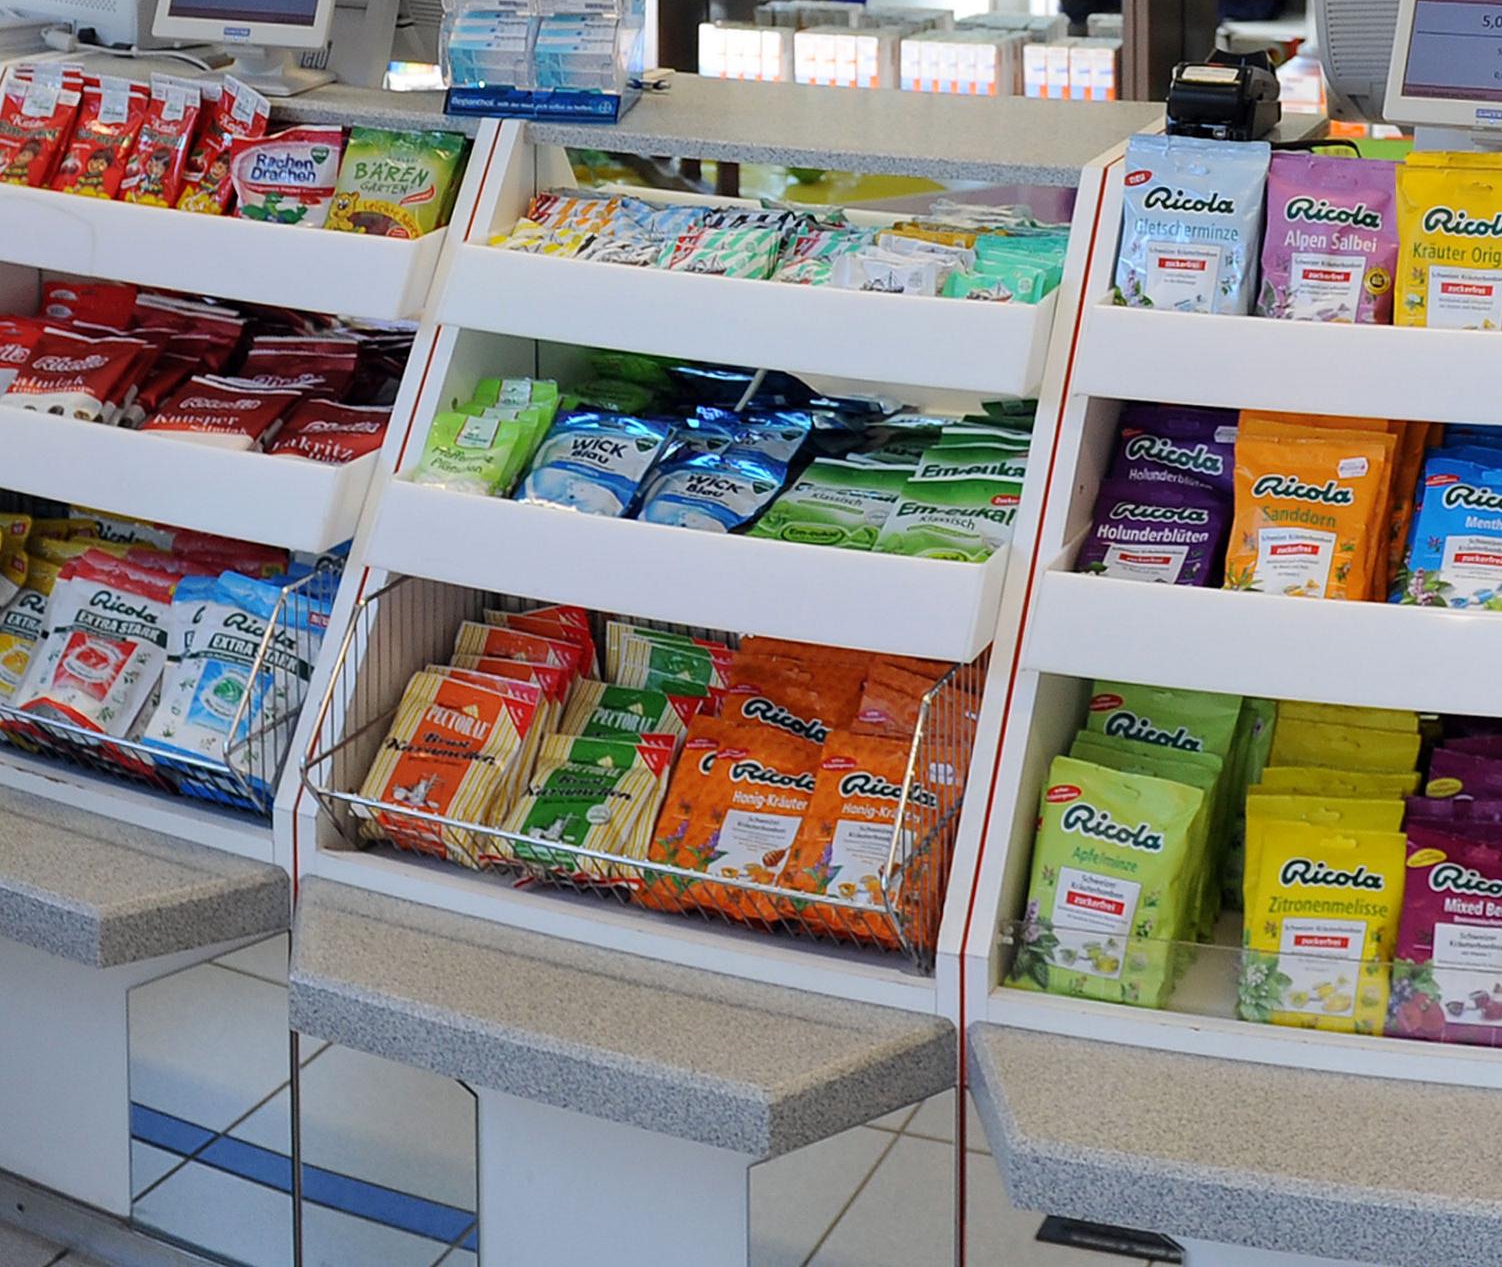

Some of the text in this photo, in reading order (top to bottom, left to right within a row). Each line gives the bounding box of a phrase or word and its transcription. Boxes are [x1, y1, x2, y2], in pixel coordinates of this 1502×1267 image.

[256, 153, 314, 171] Rachen
[354, 162, 429, 182] BÄREN
[251, 166, 316, 182] Drachen
[1144, 186, 1235, 214] Ricola
[1286, 198, 1380, 229] Ricola
[1135, 218, 1239, 241] Gletscherminze
[1284, 230, 1378, 253] Alpen Salbei
[1412, 242, 1466, 263] Kräuter
[571, 438, 628, 458] WICK
[687, 474, 744, 493] WICK
[1262, 506, 1337, 527] Sanddorn
[1097, 525, 1209, 544] Holunderblüten
[90, 591, 158, 624] Ricola
[78, 610, 160, 642] EXTRA STARK
[743, 698, 831, 744] Ricola
[733, 791, 808, 810] Honig-Kräuter
[1269, 896, 1388, 918] Zitronenmelisse
[1444, 898, 1483, 916] Mixed
